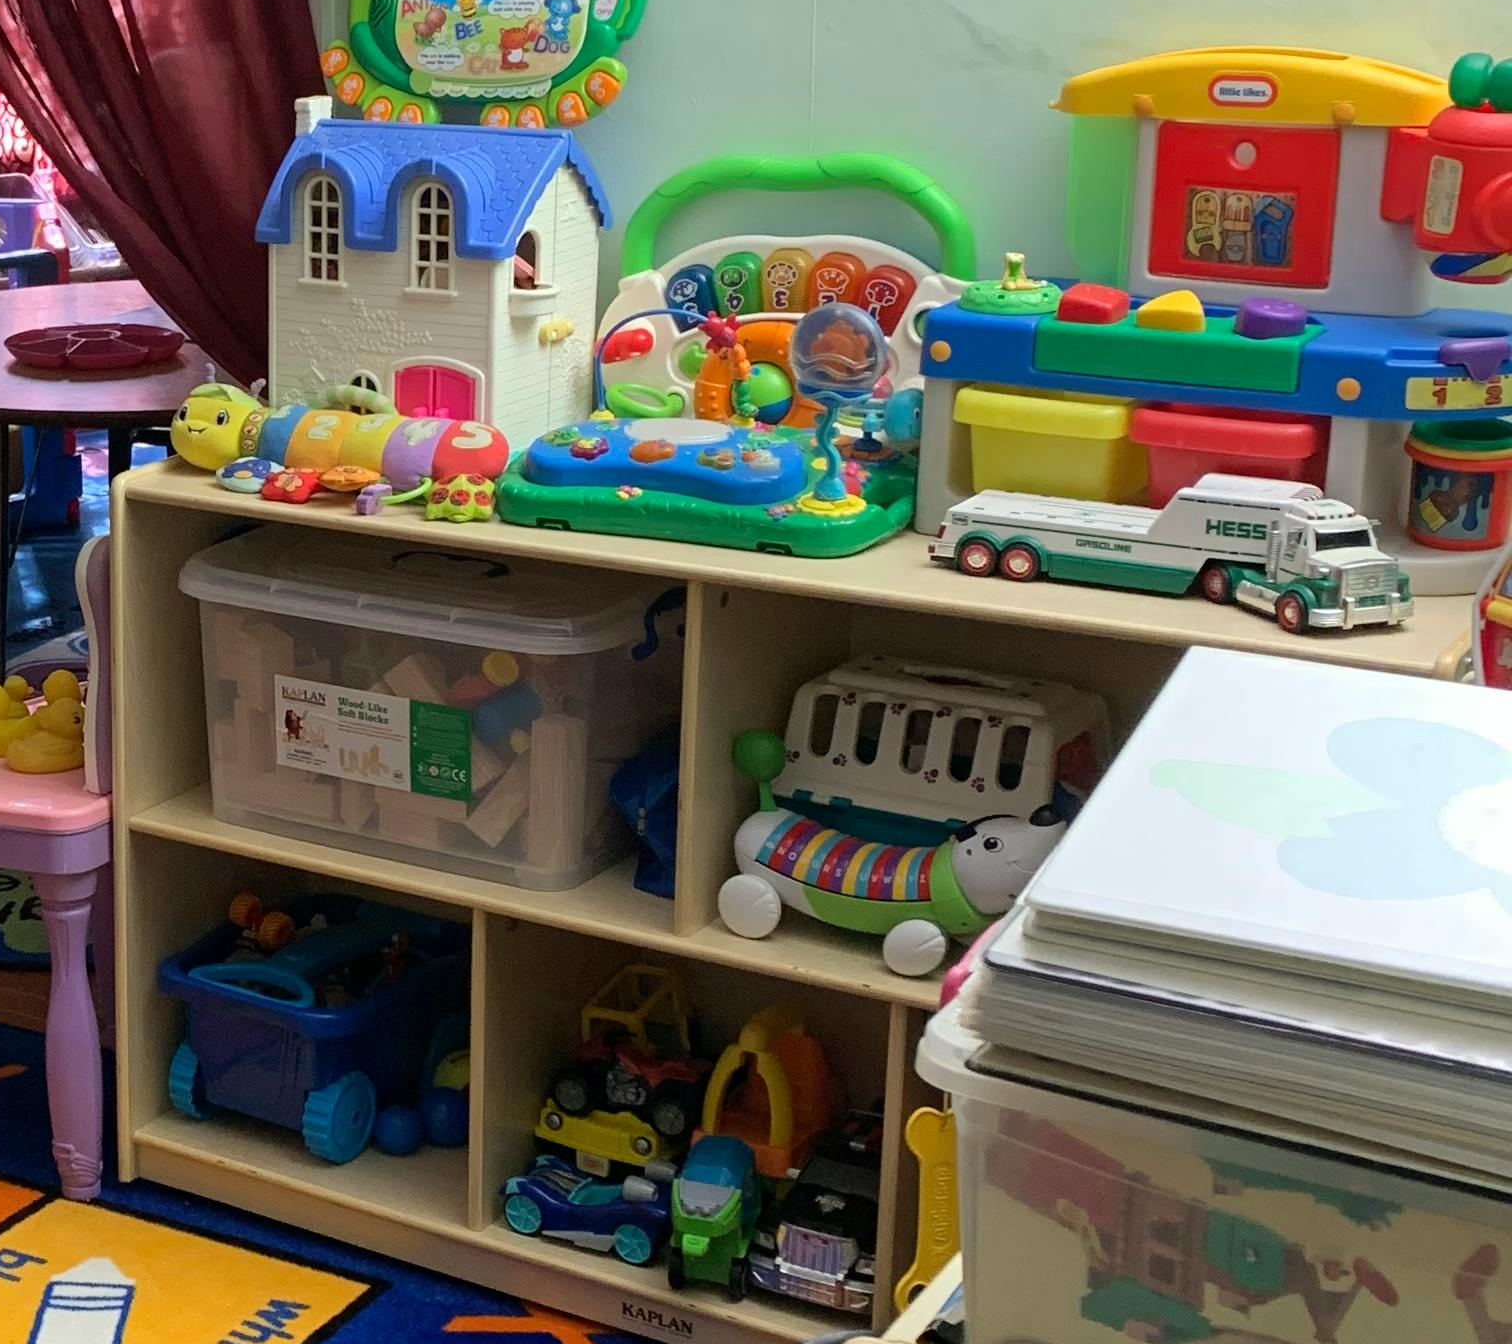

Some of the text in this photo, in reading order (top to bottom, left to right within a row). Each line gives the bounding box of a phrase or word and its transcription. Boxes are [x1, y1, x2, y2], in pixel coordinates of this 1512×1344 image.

[454, 20, 484, 41] BEE
[534, 36, 570, 54] DOG
[724, 292, 744, 312] 4
[773, 290, 789, 310] 3
[307, 415, 341, 441] 2
[403, 419, 443, 446] 4
[451, 421, 497, 449] 5
[1205, 518, 1268, 540] HESS
[1075, 537, 1133, 554] GASOLINE
[281, 685, 327, 703] KAPLAN
[338, 707, 389, 725] Soft Blocks
[621, 1300, 694, 1336] KAPLAN
